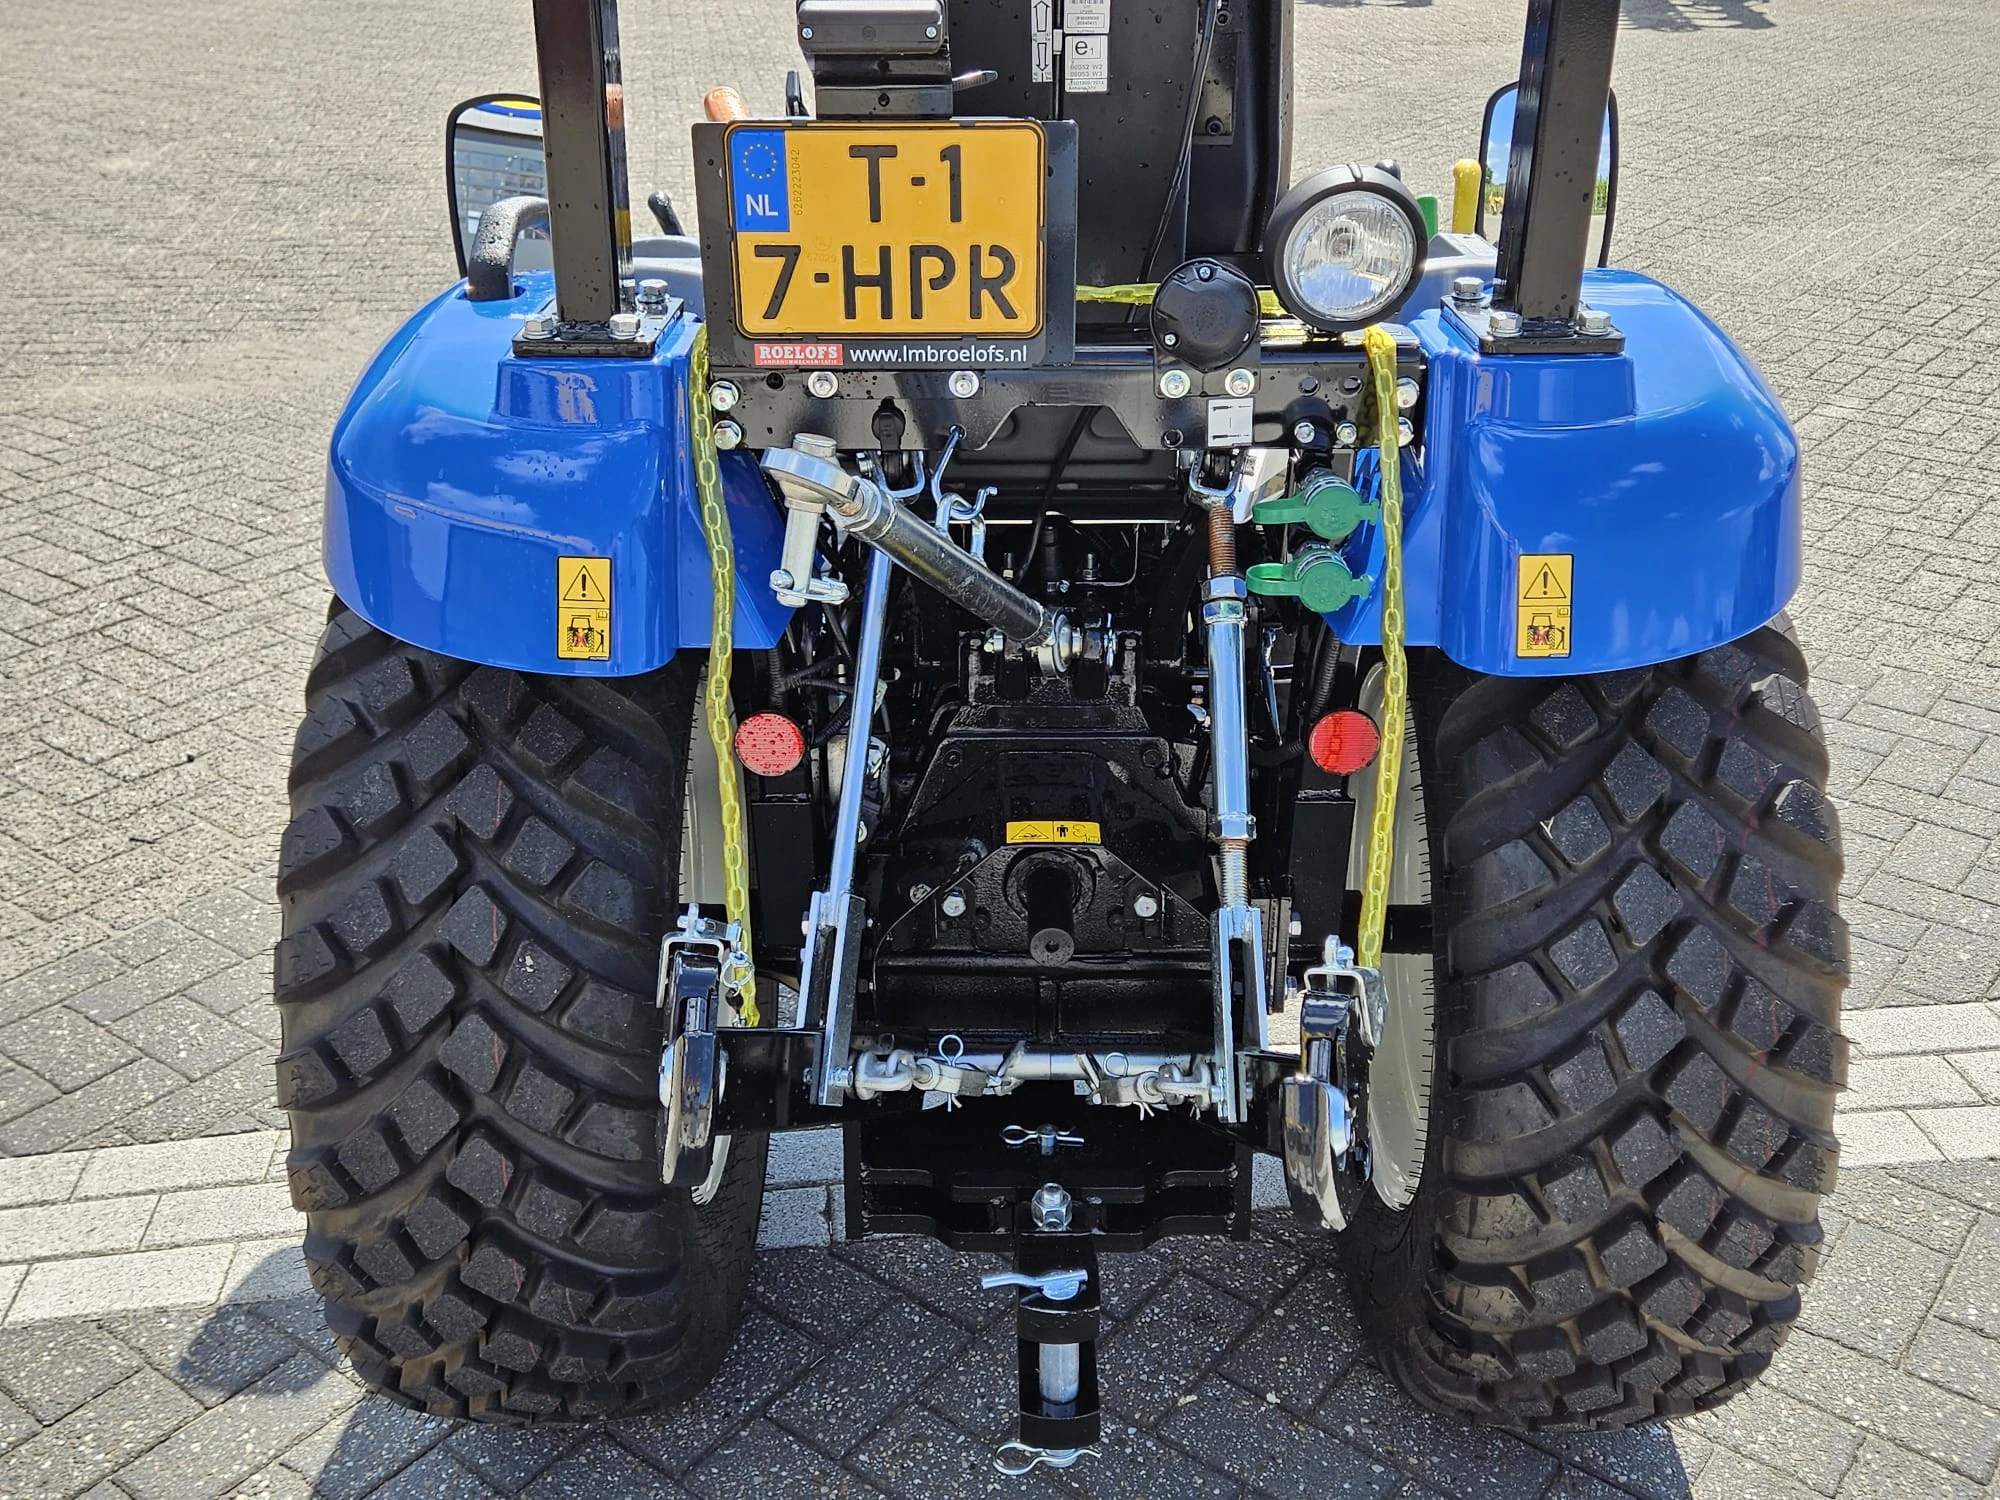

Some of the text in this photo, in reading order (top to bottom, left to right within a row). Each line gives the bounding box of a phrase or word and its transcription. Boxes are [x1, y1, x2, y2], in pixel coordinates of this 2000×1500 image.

[848, 144, 962, 223] T-1
[745, 193, 779, 218] NL
[754, 244, 1018, 320] 7-HPR
[759, 345, 838, 359] ROELOFS
[849, 344, 1028, 363] www.lmbroelofs.nl
